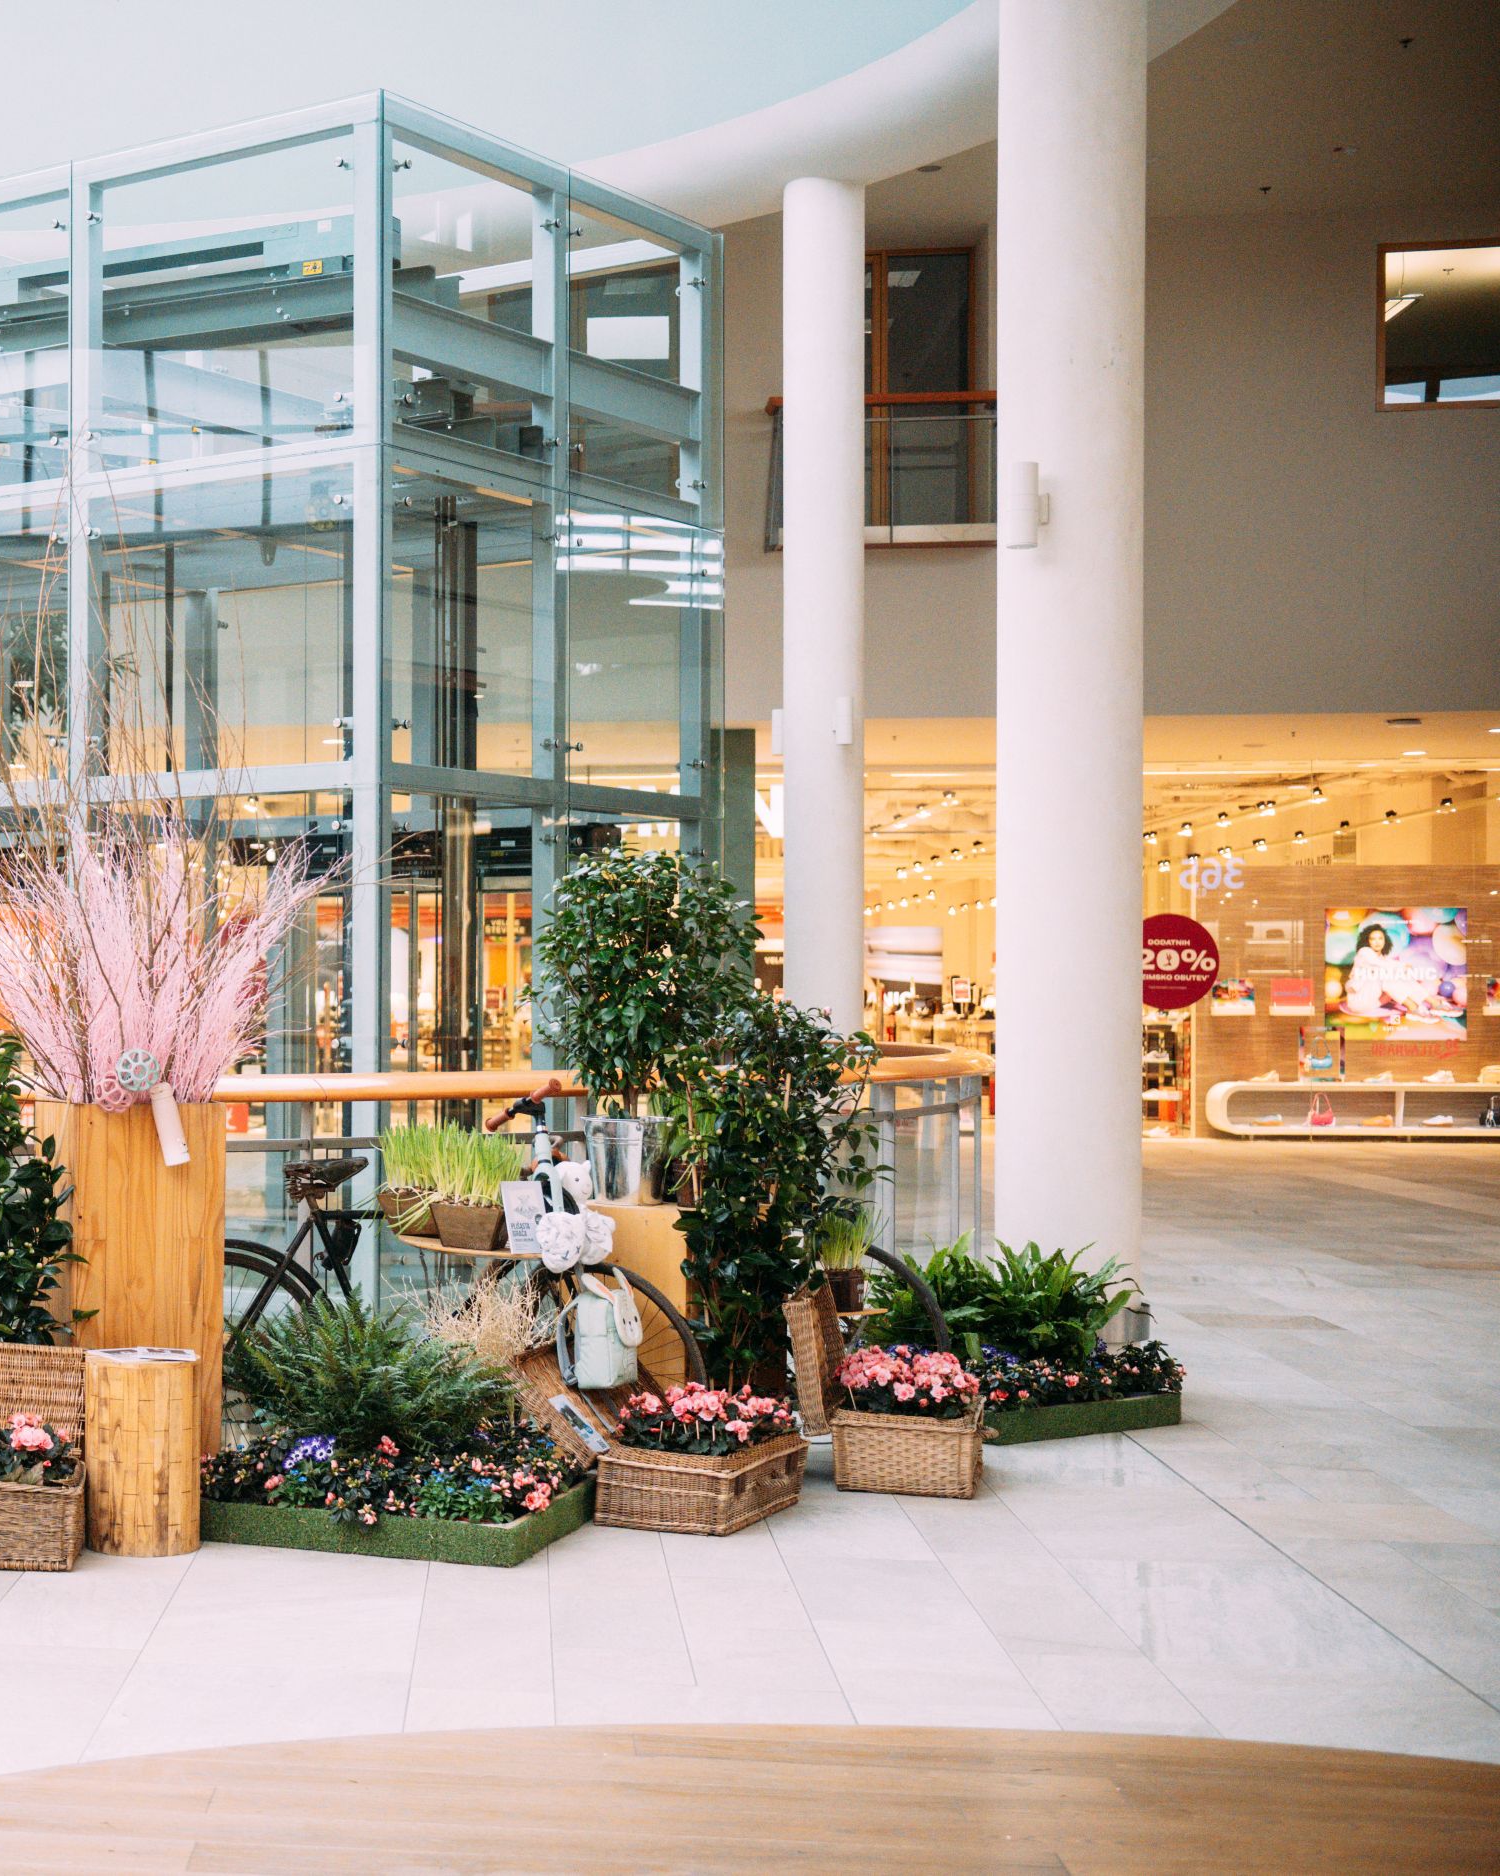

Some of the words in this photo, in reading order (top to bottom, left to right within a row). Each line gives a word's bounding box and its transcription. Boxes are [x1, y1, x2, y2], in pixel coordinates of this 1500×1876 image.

[1147, 938, 1191, 947] DODATNIH
[1143, 949, 1217, 971] 20%
[1355, 967, 1438, 979] HUMANIC
